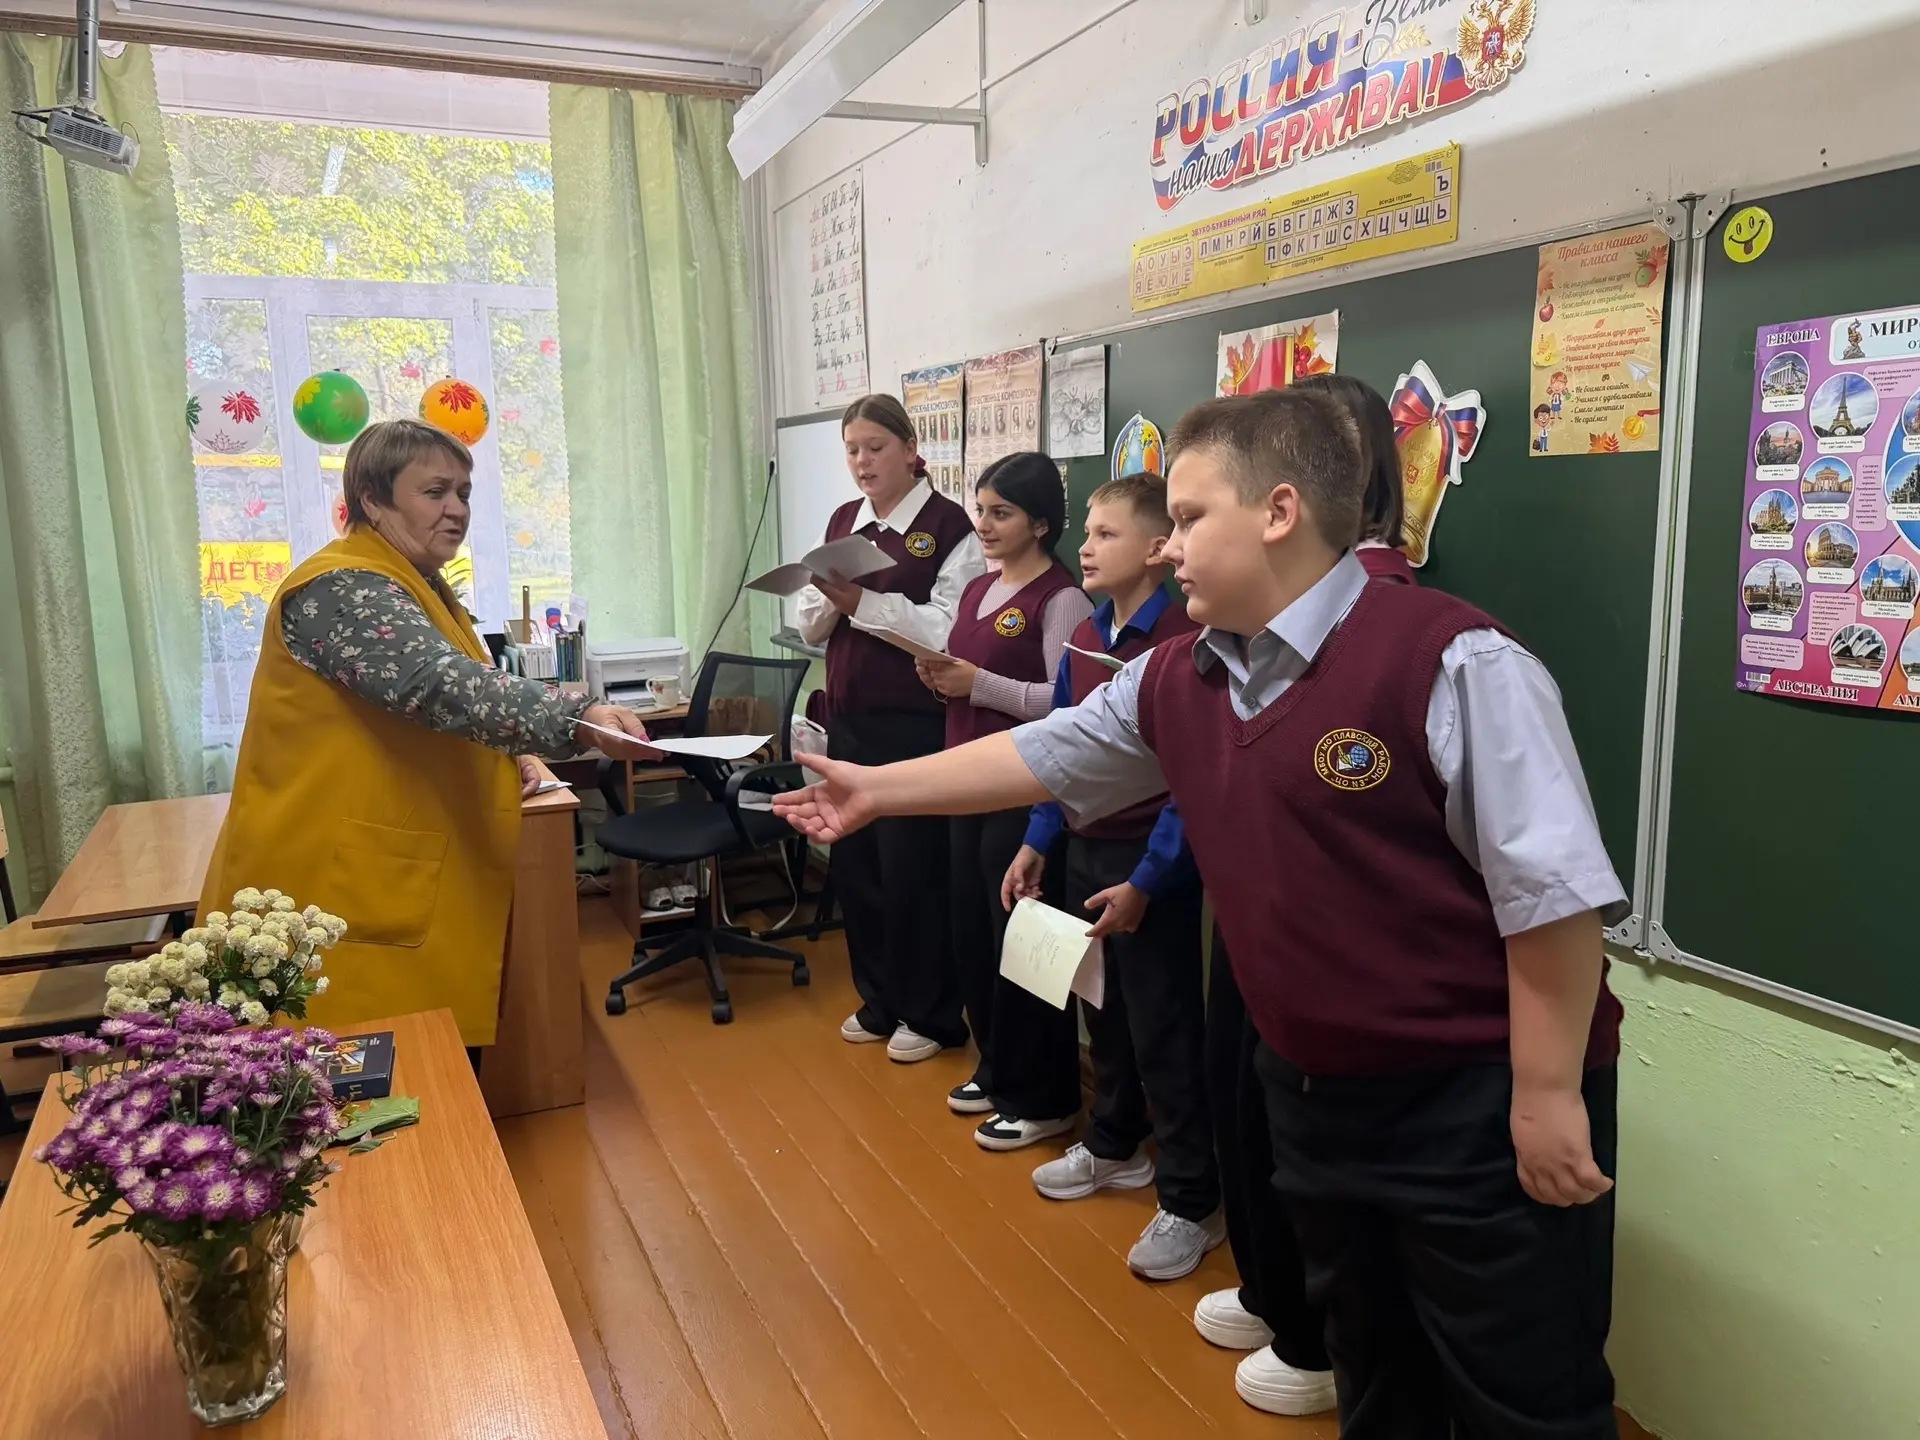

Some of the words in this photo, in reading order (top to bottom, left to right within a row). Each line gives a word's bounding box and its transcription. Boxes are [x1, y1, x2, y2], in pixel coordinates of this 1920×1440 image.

[1167, 148, 1234, 199] наша
[1233, 48, 1450, 185] ДЕРЖАВА!
[1437, 175, 1448, 192] Ъ
[1252, 208, 1267, 219] РЯД
[1212, 239, 1221, 253] М
[1226, 235, 1233, 249] Н
[1240, 231, 1246, 245] Р
[1253, 223, 1261, 240] Й
[1268, 222, 1276, 237] Б
[1283, 218, 1291, 233] В
[1299, 213, 1306, 228] Г
[1312, 210, 1322, 227] Д
[1327, 203, 1339, 221] Ж
[1345, 200, 1354, 215] З
[1268, 245, 1276, 261] П
[1282, 241, 1292, 257] Ф
[1297, 238, 1305, 253] К
[1313, 233, 1320, 249] Т
[1326, 229, 1337, 246] Ш
[1342, 225, 1352, 241] С
[1360, 221, 1370, 238] Х
[1379, 215, 1389, 235] Ц
[1399, 213, 1408, 228] Ч
[1415, 207, 1430, 225] Щ
[1437, 204, 1446, 219] Ь
[1558, 240, 1603, 261] Правила
[1605, 233, 1648, 250] нашего
[1136, 261, 1142, 274] А
[1148, 257, 1155, 270] О
[1160, 253, 1166, 267] У
[1171, 249, 1180, 264] Ы
[1185, 246, 1191, 260] Э
[1580, 252, 1619, 268] класса
[1767, 328, 1821, 346] ЕВРОПА
[1574, 405, 1594, 414] Смело
[1774, 679, 1859, 701] АВСТРАЛИЯ
[1321, 738, 1333, 751] МО
[1318, 752, 1329, 775] МБОУ
[1371, 750, 1387, 780] РАЙОН
